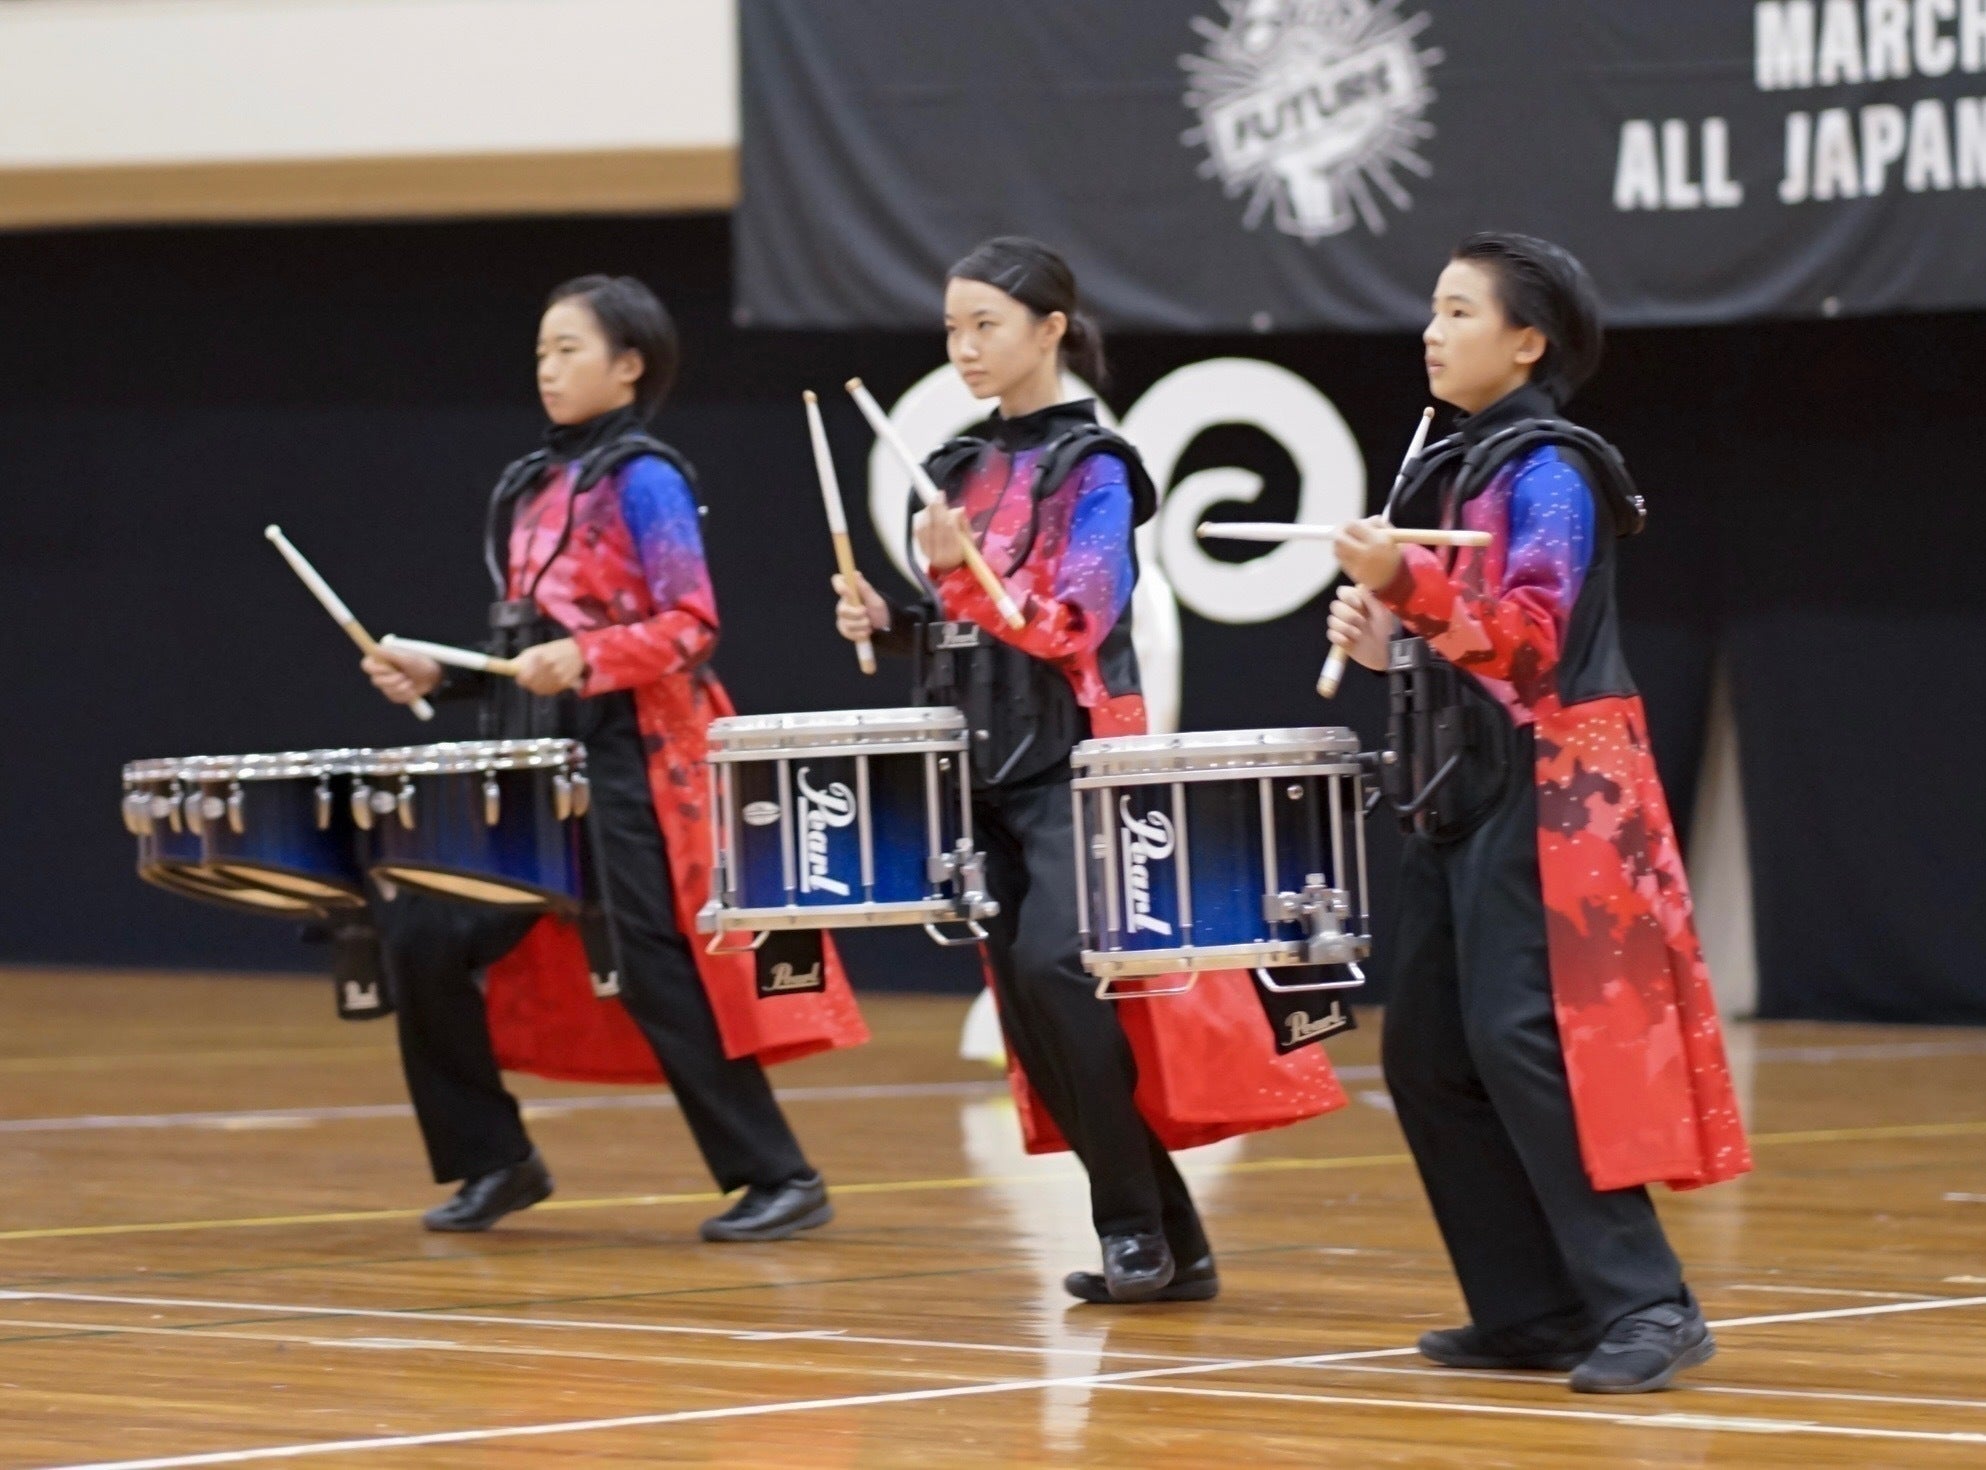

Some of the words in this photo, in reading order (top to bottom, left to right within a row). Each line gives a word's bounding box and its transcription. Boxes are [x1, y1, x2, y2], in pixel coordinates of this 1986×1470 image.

[1613, 117, 1744, 210] ALL
[1778, 97, 1986, 205] JAPAN
[797, 766, 856, 896] Pearl
[1119, 793, 1176, 936] Pearl
